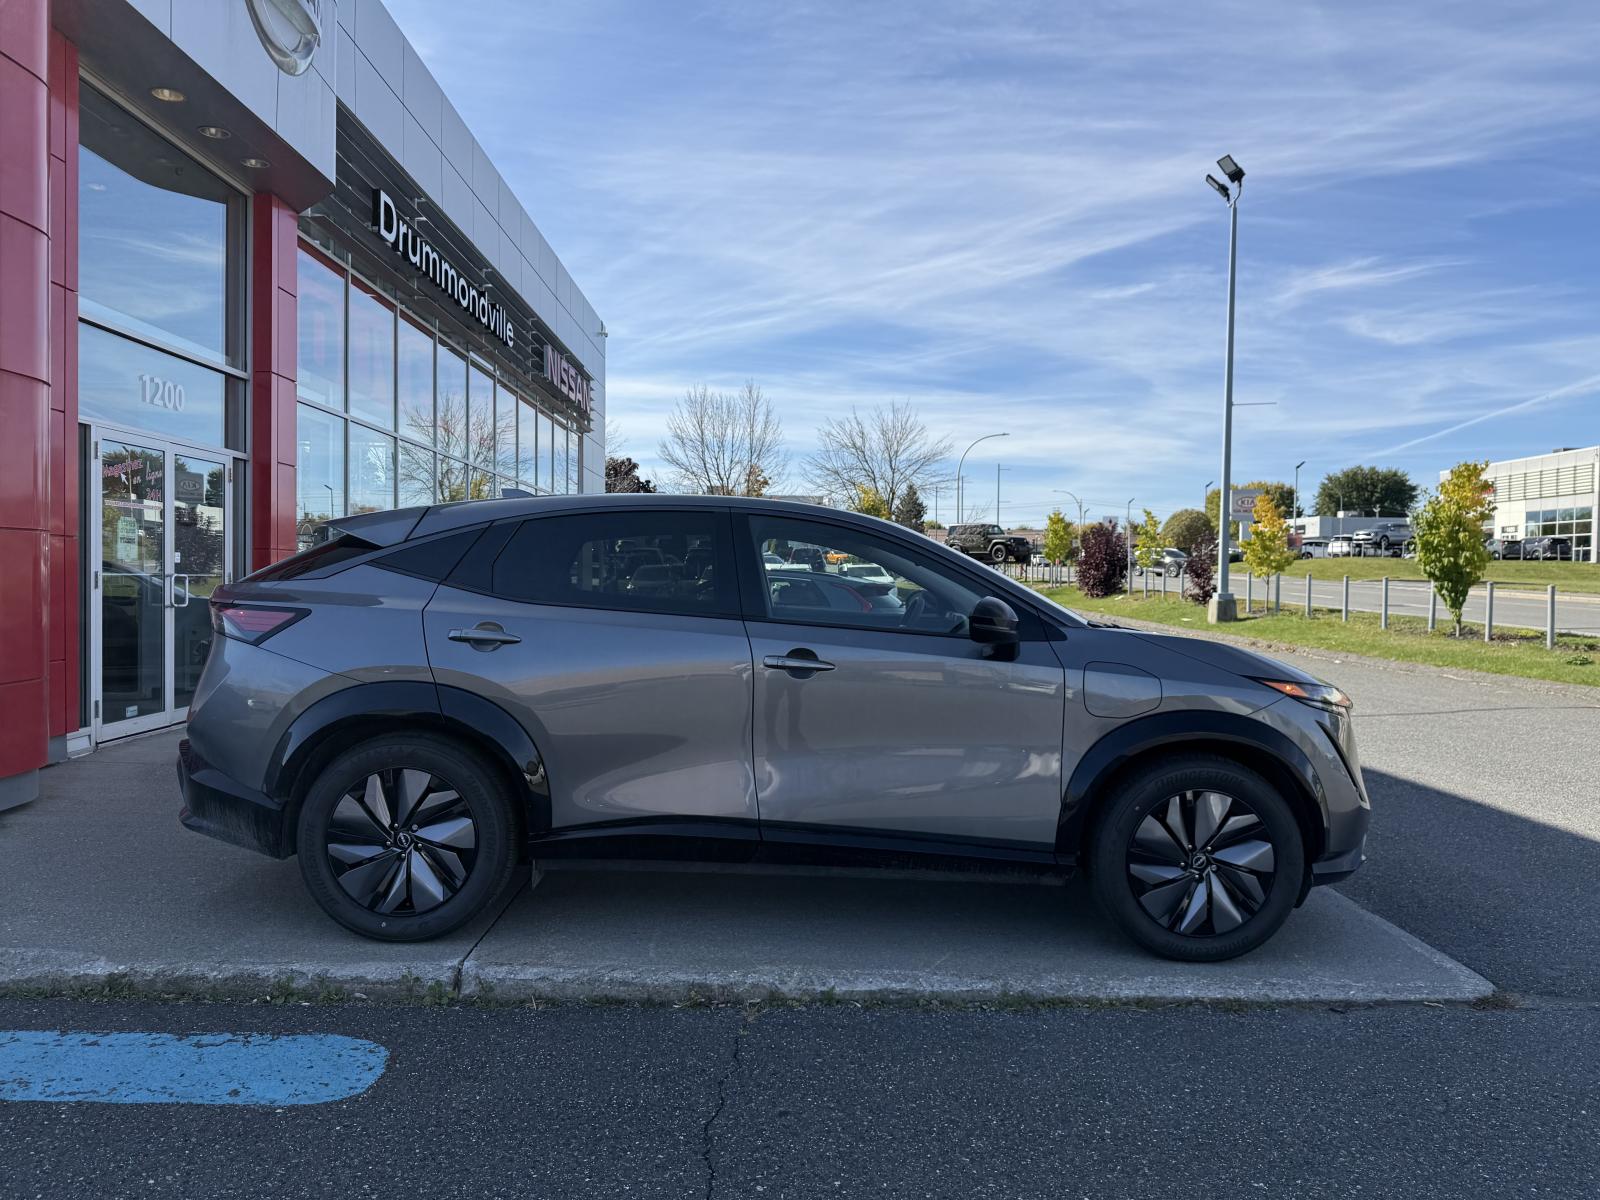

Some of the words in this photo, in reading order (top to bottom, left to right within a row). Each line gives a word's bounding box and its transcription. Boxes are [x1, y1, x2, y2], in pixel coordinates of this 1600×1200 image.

[372, 189, 514, 348] Drummondville
[139, 374, 184, 412] 1200
[545, 345, 591, 415] NISSAN
[1154, 770, 1246, 792] BRIDGESTONE
